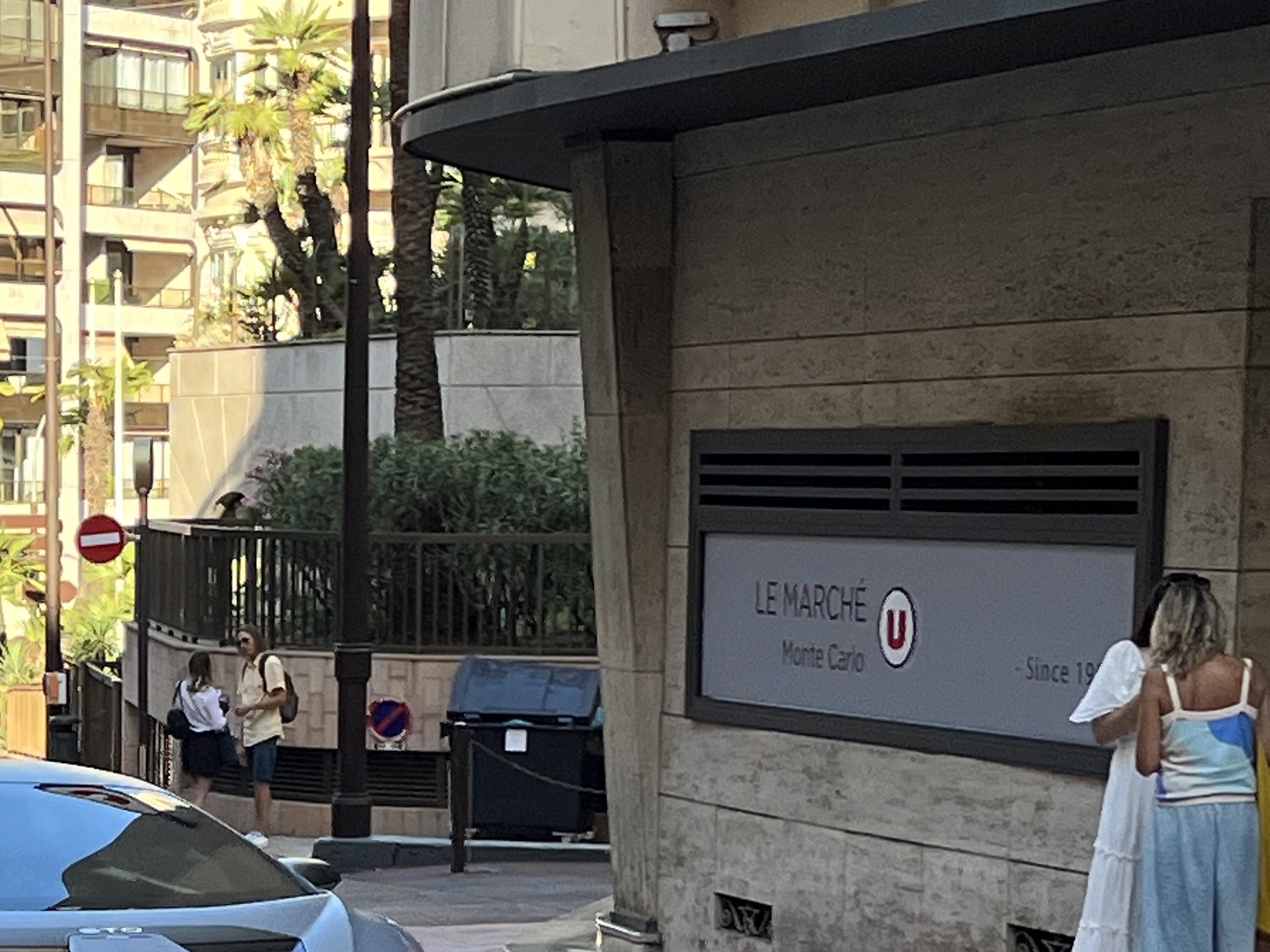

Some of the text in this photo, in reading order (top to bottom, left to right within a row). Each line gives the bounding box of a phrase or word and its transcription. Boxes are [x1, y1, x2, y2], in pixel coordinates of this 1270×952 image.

[756, 577, 868, 623] LE MARCHÉ
[782, 640, 865, 673] Monte Carlo
